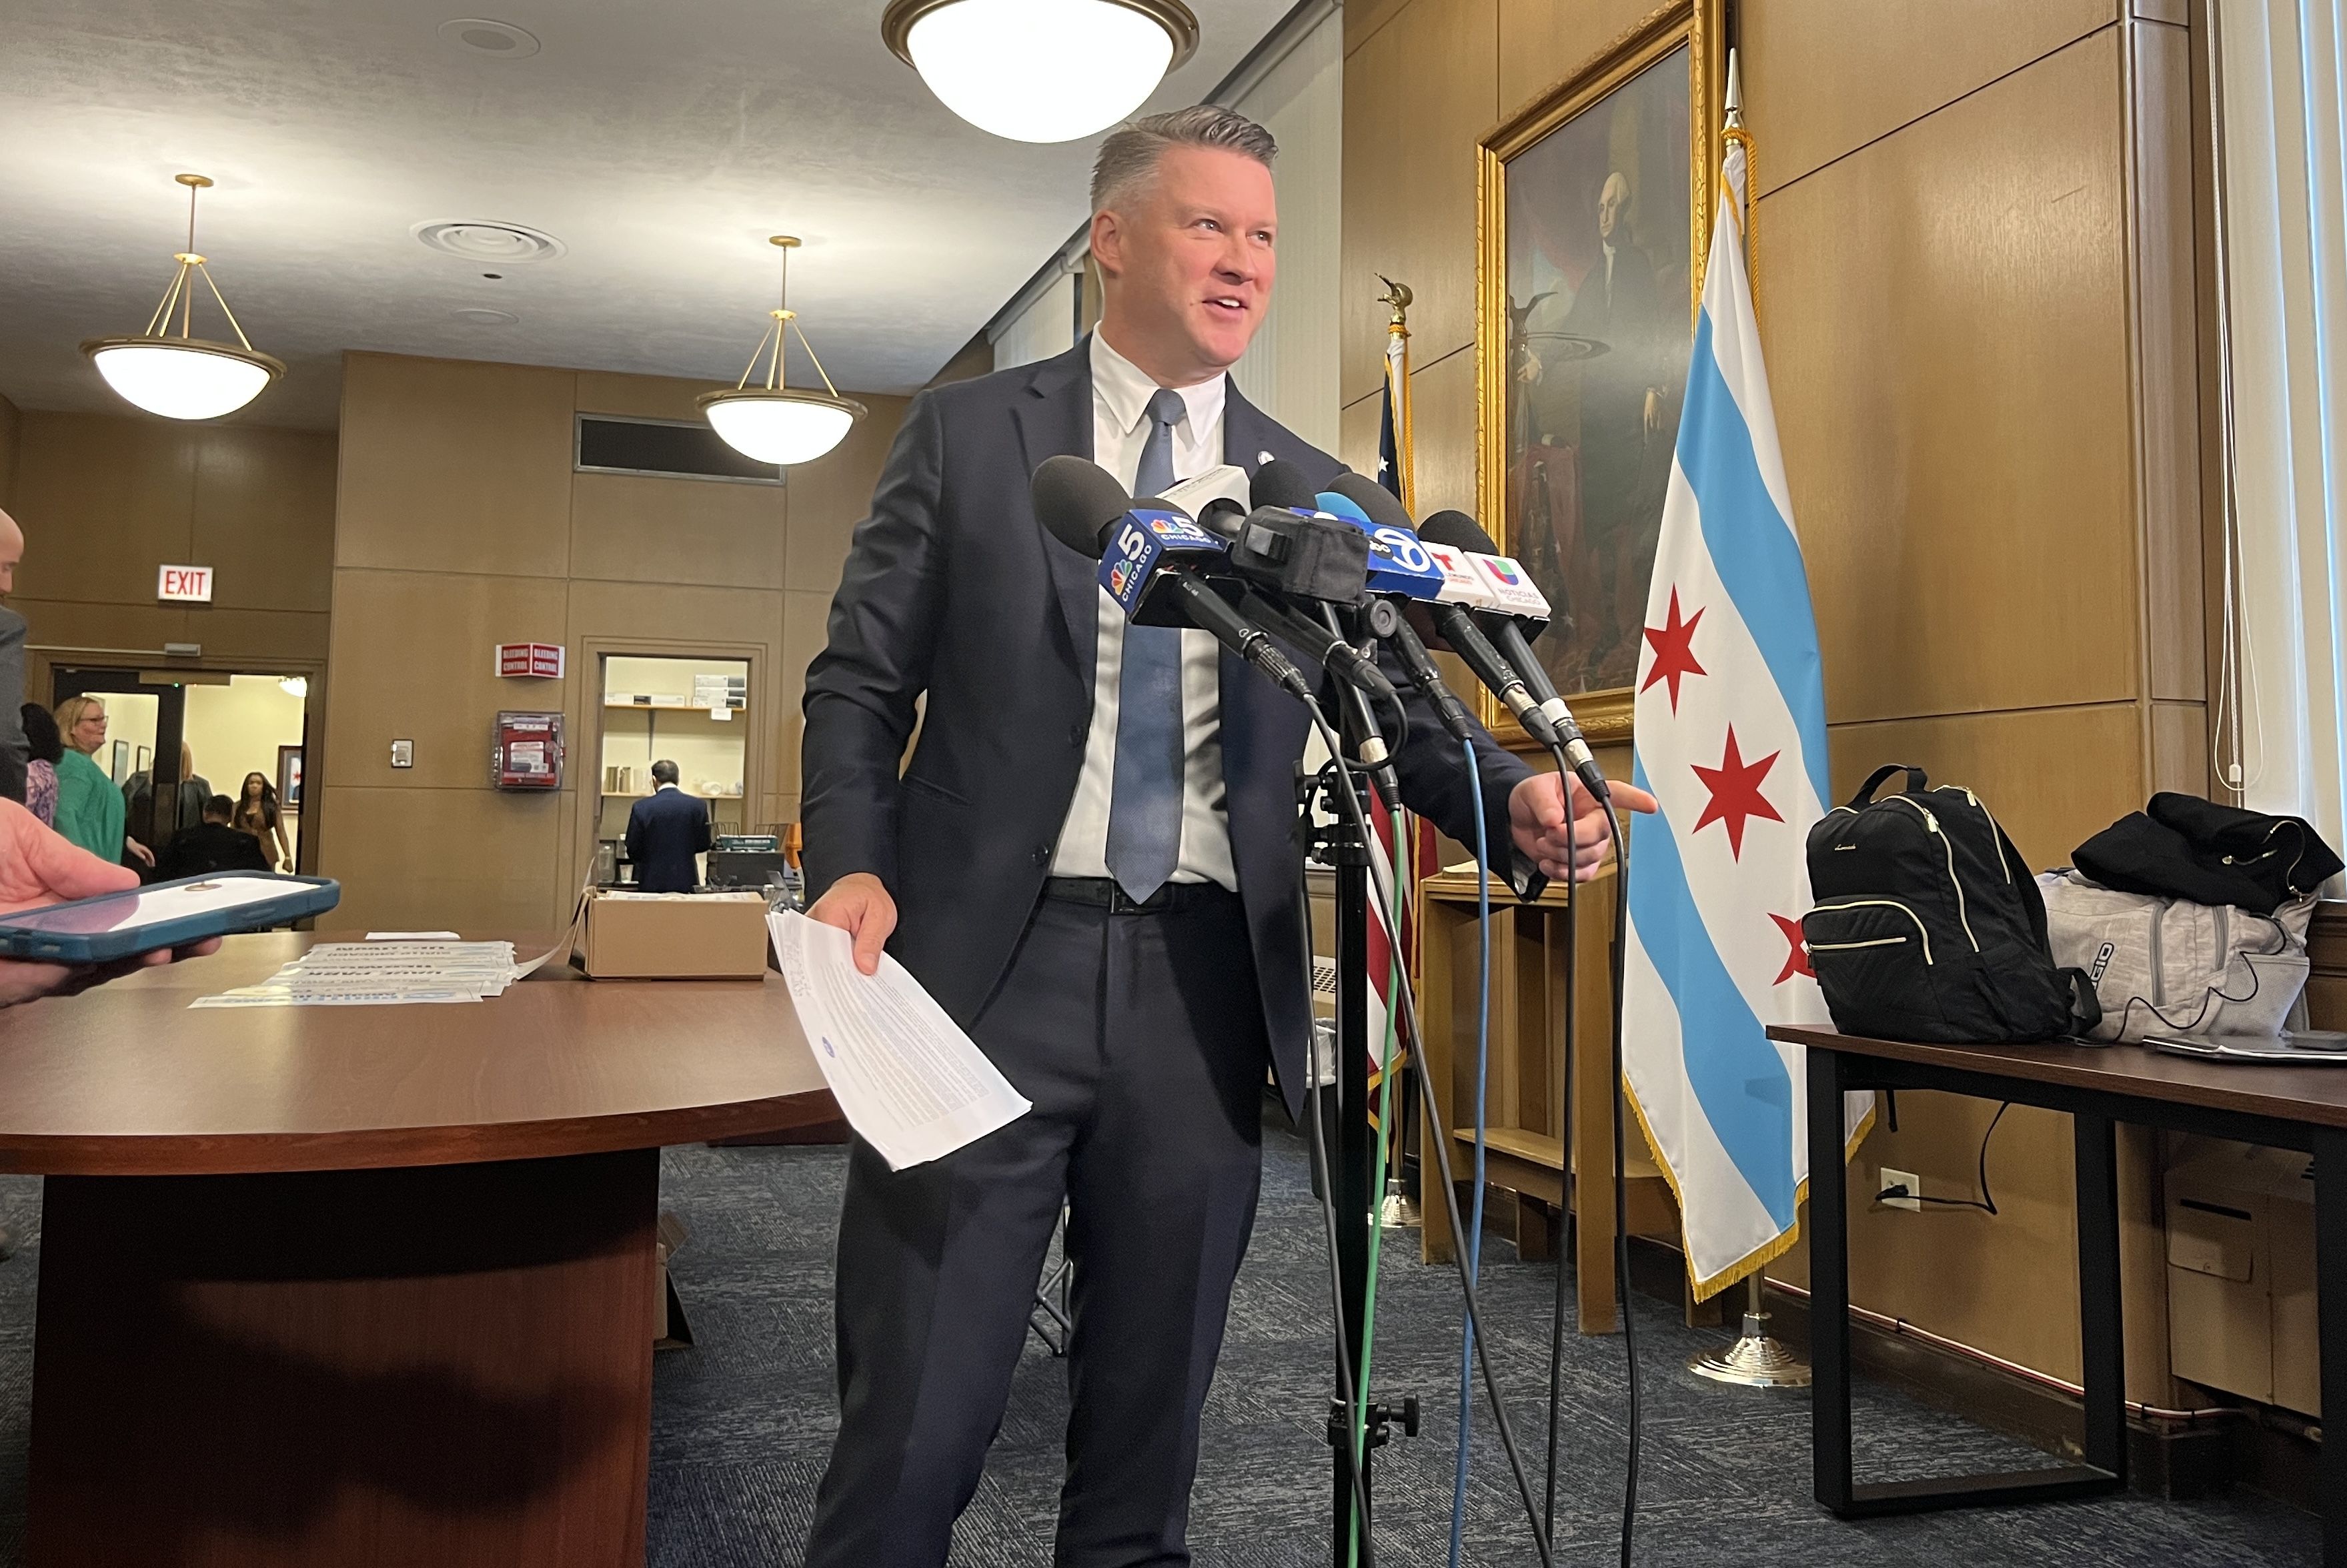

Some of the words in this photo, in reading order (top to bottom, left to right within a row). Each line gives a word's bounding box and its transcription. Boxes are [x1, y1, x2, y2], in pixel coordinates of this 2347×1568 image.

[1172, 516, 1204, 537] 5
[1118, 524, 1144, 561] 5
[1160, 534, 1212, 544] CHICAGO
[165, 570, 206, 596] EXIT
[1122, 544, 1152, 602] CHICAGO
[1497, 588, 1539, 599] NOTICIAS
[503, 648, 529, 660] BLEEDING
[534, 648, 558, 660] BLEEDING
[2090, 942, 2114, 991] GIO
